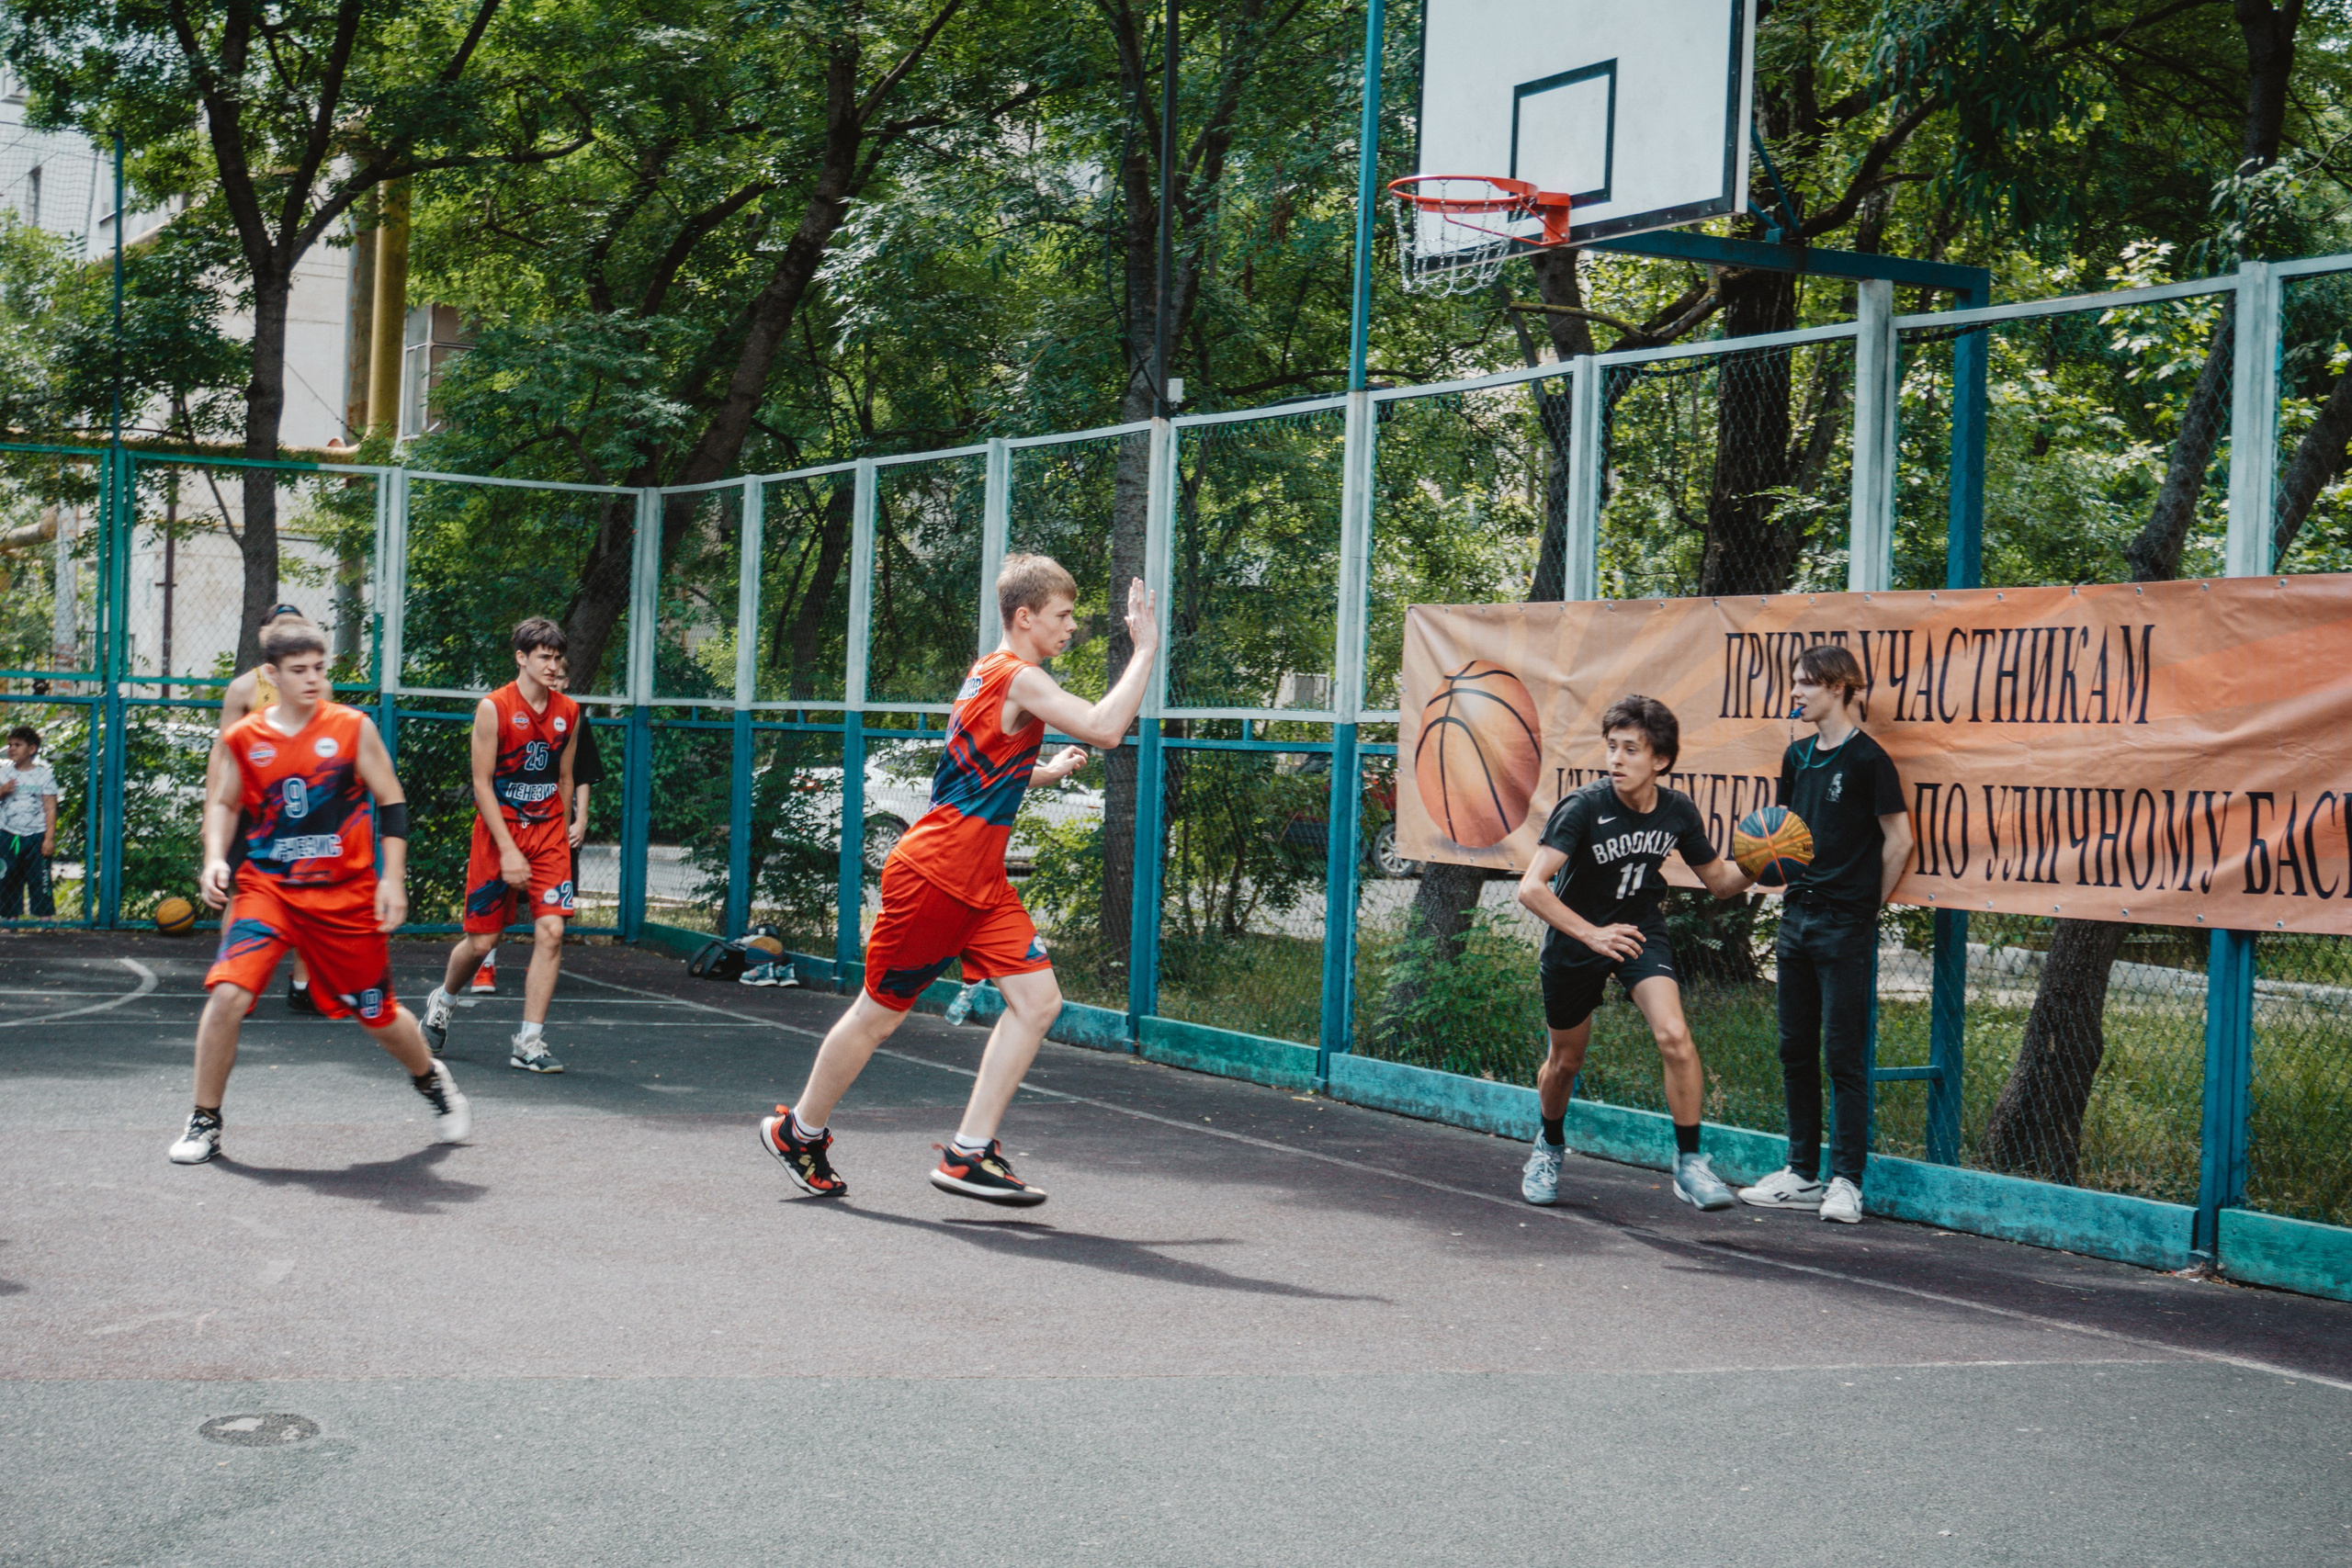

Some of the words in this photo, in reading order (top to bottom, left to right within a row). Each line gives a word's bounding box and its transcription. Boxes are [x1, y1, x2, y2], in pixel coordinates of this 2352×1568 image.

[1859, 624, 2155, 724] УЧАСТНИКАМ
[524, 740, 550, 771] 25
[281, 777, 309, 818] 9
[1914, 782, 1969, 880] ПО
[1981, 784, 2233, 895] УЛИЧНОМУ
[1615, 863, 1647, 899] 11
[359, 987, 383, 1020] 9
